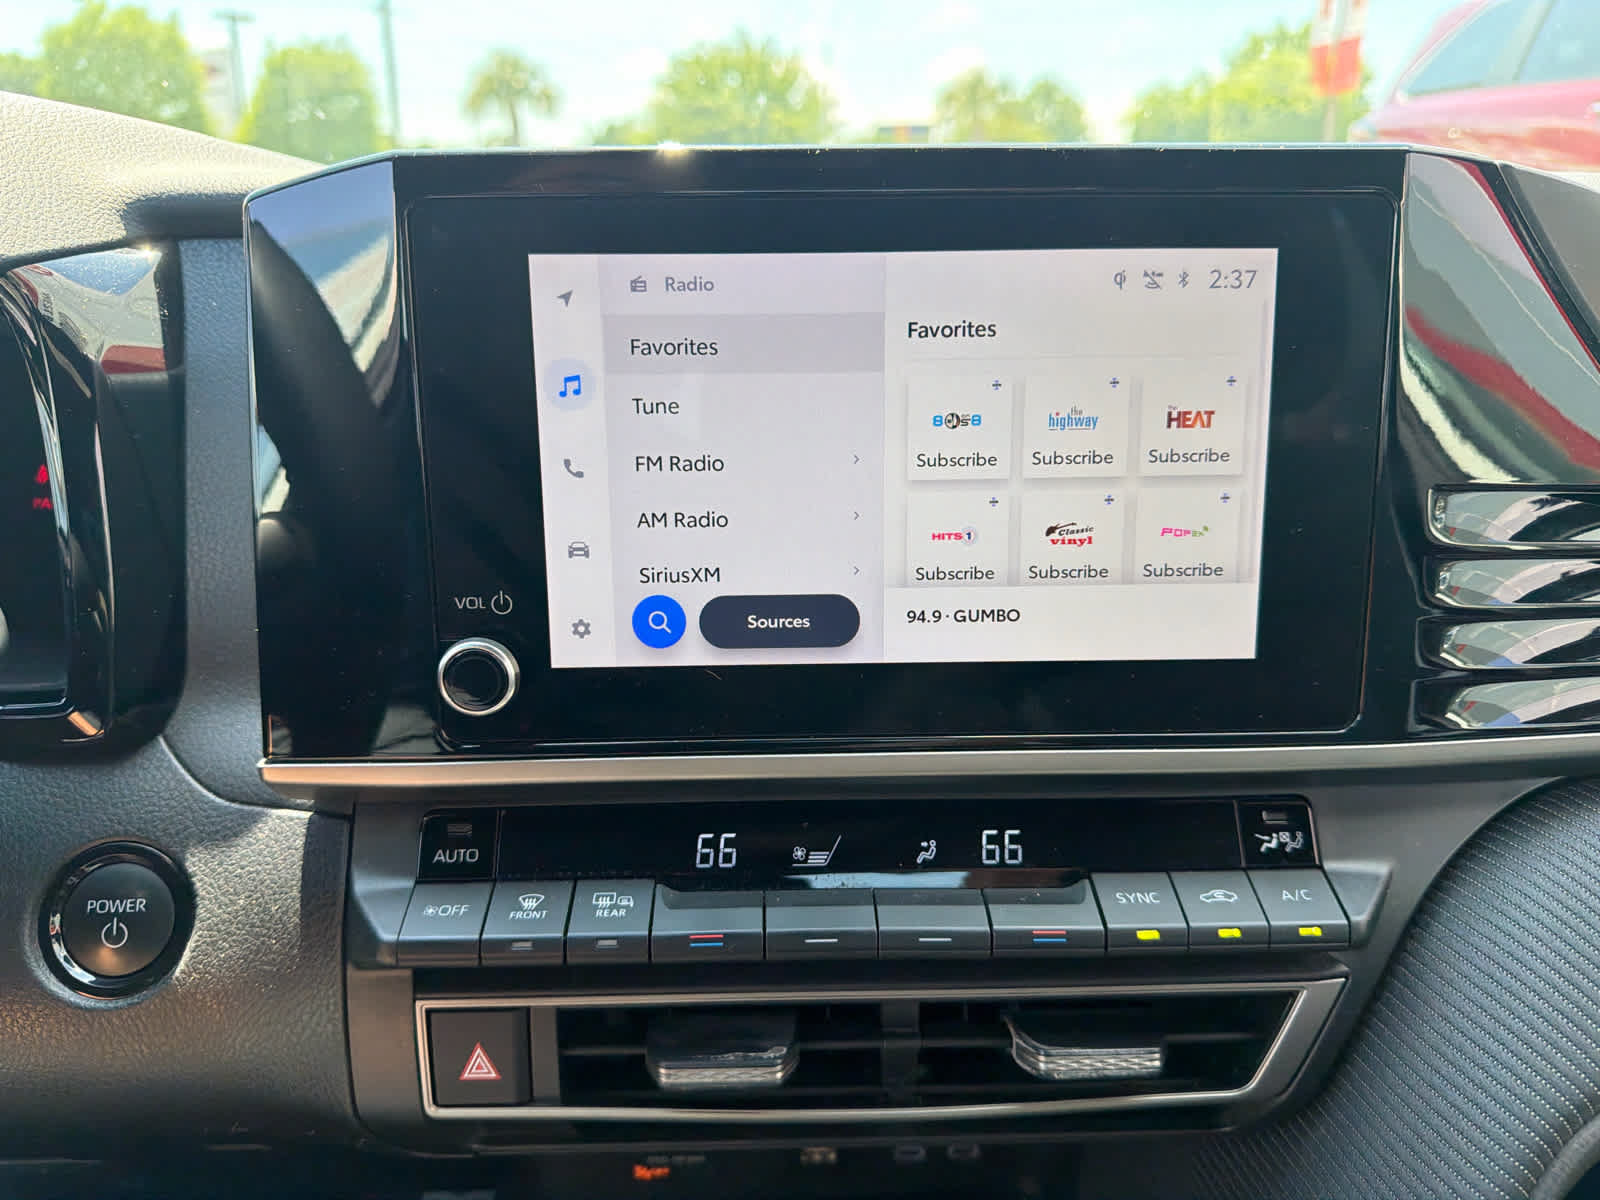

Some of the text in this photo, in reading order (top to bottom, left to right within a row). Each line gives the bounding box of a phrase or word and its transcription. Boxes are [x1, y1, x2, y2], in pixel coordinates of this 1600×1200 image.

[664, 276, 715, 292] Radio
[1209, 269, 1258, 289] 2:37
[907, 321, 997, 338] Favorites
[630, 338, 719, 356] Favorites
[631, 398, 680, 415] Tune
[1048, 411, 1099, 431] highway
[1166, 410, 1216, 429] HEAT
[635, 455, 725, 472] FM Radio
[916, 452, 998, 468] Subscribe
[1031, 450, 1114, 466] Subscribe
[1148, 448, 1231, 464] Subscribe
[637, 511, 729, 528] AM Radio
[931, 532, 963, 541] HITS
[1050, 536, 1093, 547] vinyl
[639, 567, 721, 584] SiriusXM
[915, 567, 995, 582] Subscribe
[1028, 565, 1109, 580] Subscribe
[1144, 564, 1224, 578] Subscribe
[454, 596, 486, 609] VOL
[747, 614, 811, 630] Sources
[906, 609, 1021, 624] 94.9 GUMBO
[695, 833, 737, 868] 66
[979, 830, 1023, 865] 66
[432, 848, 479, 864] AUTO
[1115, 891, 1161, 905] SYNC
[1281, 888, 1312, 902] A/C
[87, 898, 147, 914] POWER
[438, 904, 470, 917] OFF
[595, 907, 627, 918] REAR
[509, 909, 548, 920] FRONT
